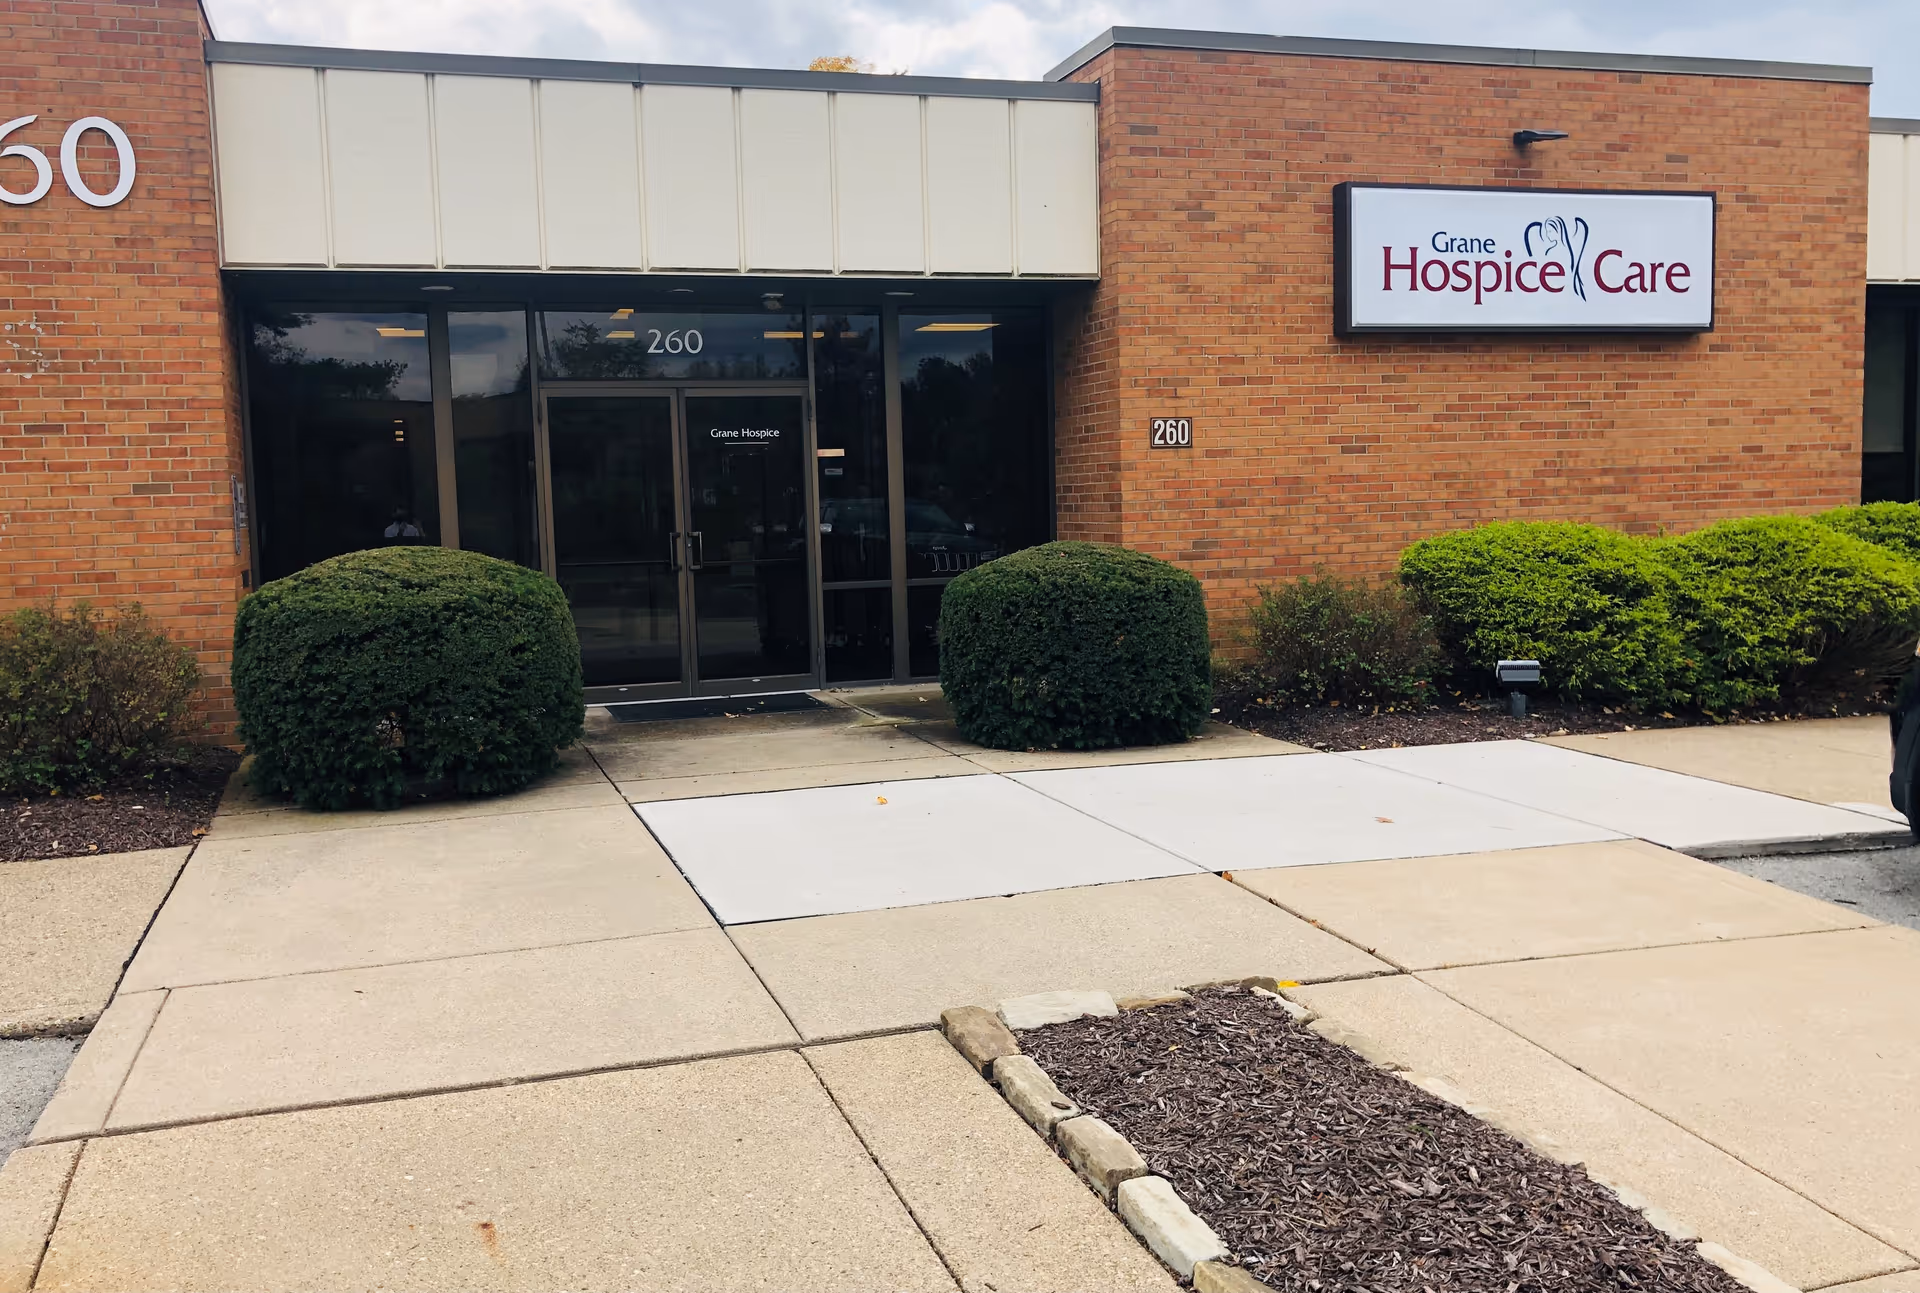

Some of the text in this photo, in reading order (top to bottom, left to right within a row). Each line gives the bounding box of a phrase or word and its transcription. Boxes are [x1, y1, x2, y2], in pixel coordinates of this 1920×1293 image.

[1431, 231, 1496, 254] Grane
[1382, 246, 1691, 305] Hospice Care
[647, 329, 703, 354] 260
[710, 428, 780, 440] Grane Hospice
[1153, 420, 1189, 445] 260
